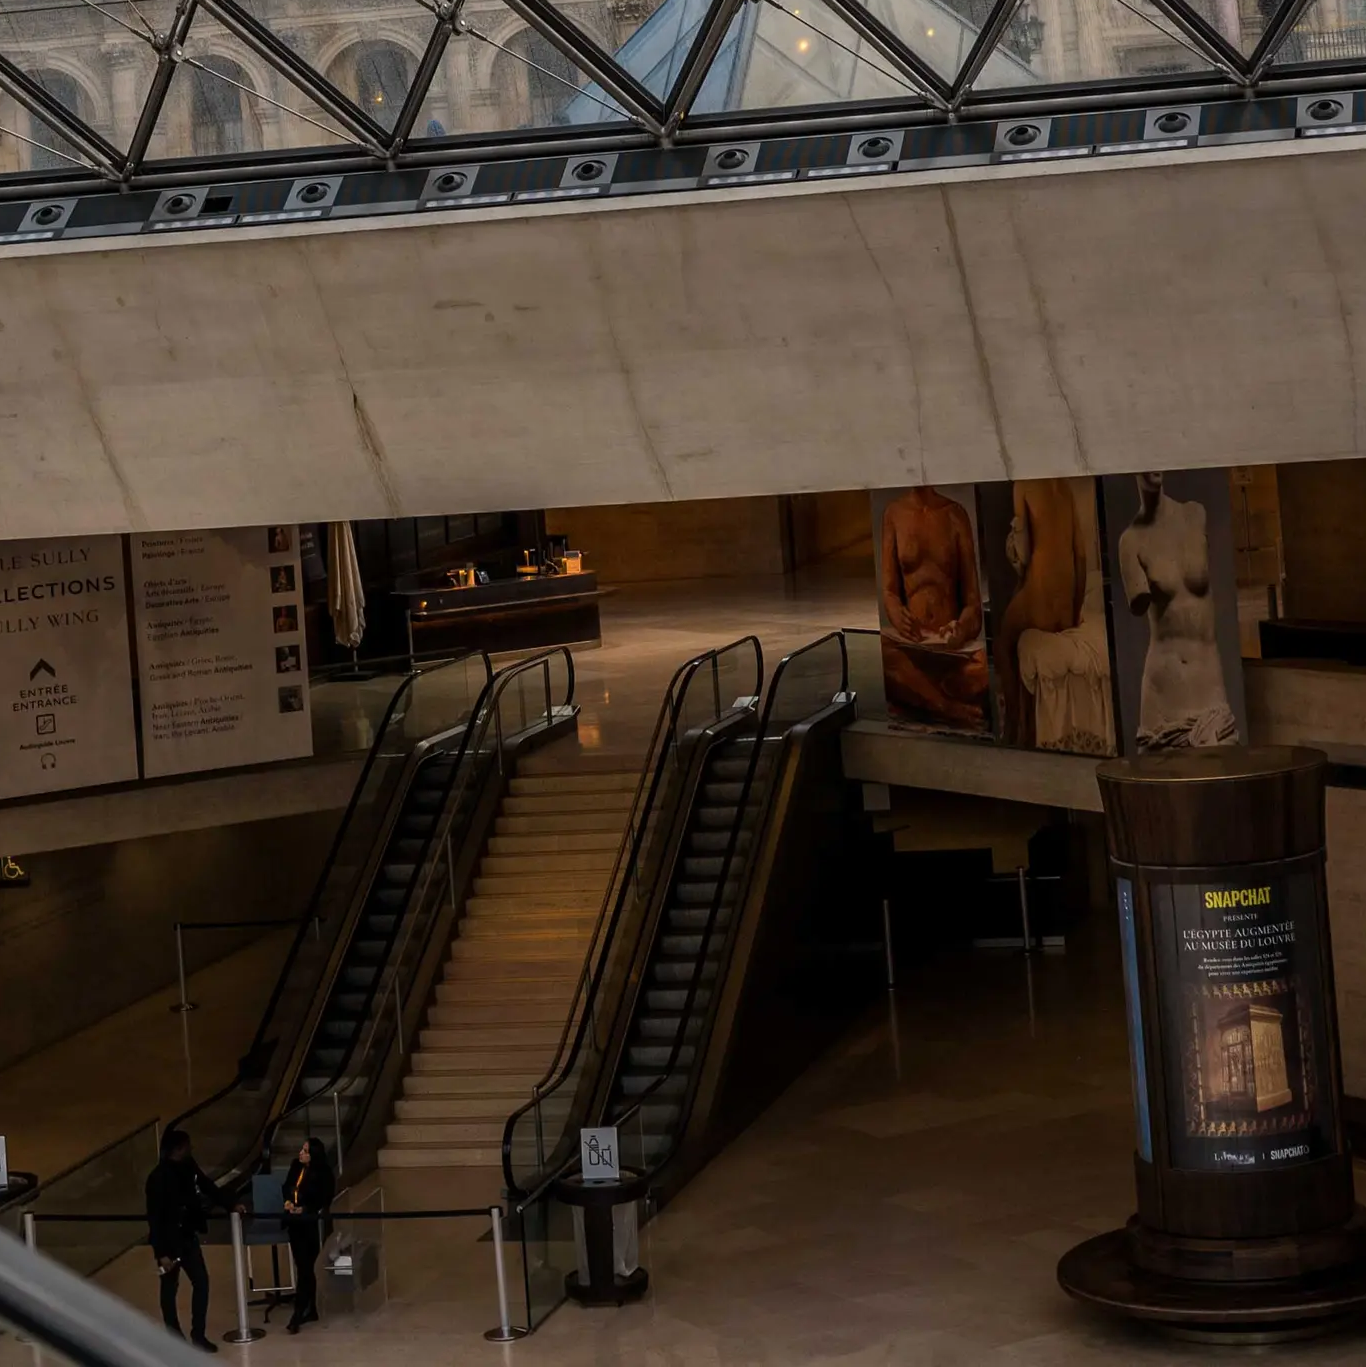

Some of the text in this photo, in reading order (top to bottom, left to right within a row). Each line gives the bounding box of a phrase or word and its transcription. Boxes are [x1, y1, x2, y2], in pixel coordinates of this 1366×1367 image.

[30, 547, 91, 568] SULLY
[47, 609, 100, 628] WING
[19, 684, 69, 699] ENTRÉE
[12, 695, 78, 712] ENTRANCE
[1204, 886, 1272, 909] SNAPCHAT
[1234, 920, 1296, 938] AUGMENTÉE
[1184, 932, 1296, 951] AU MUSÉE DU LOUVRE
